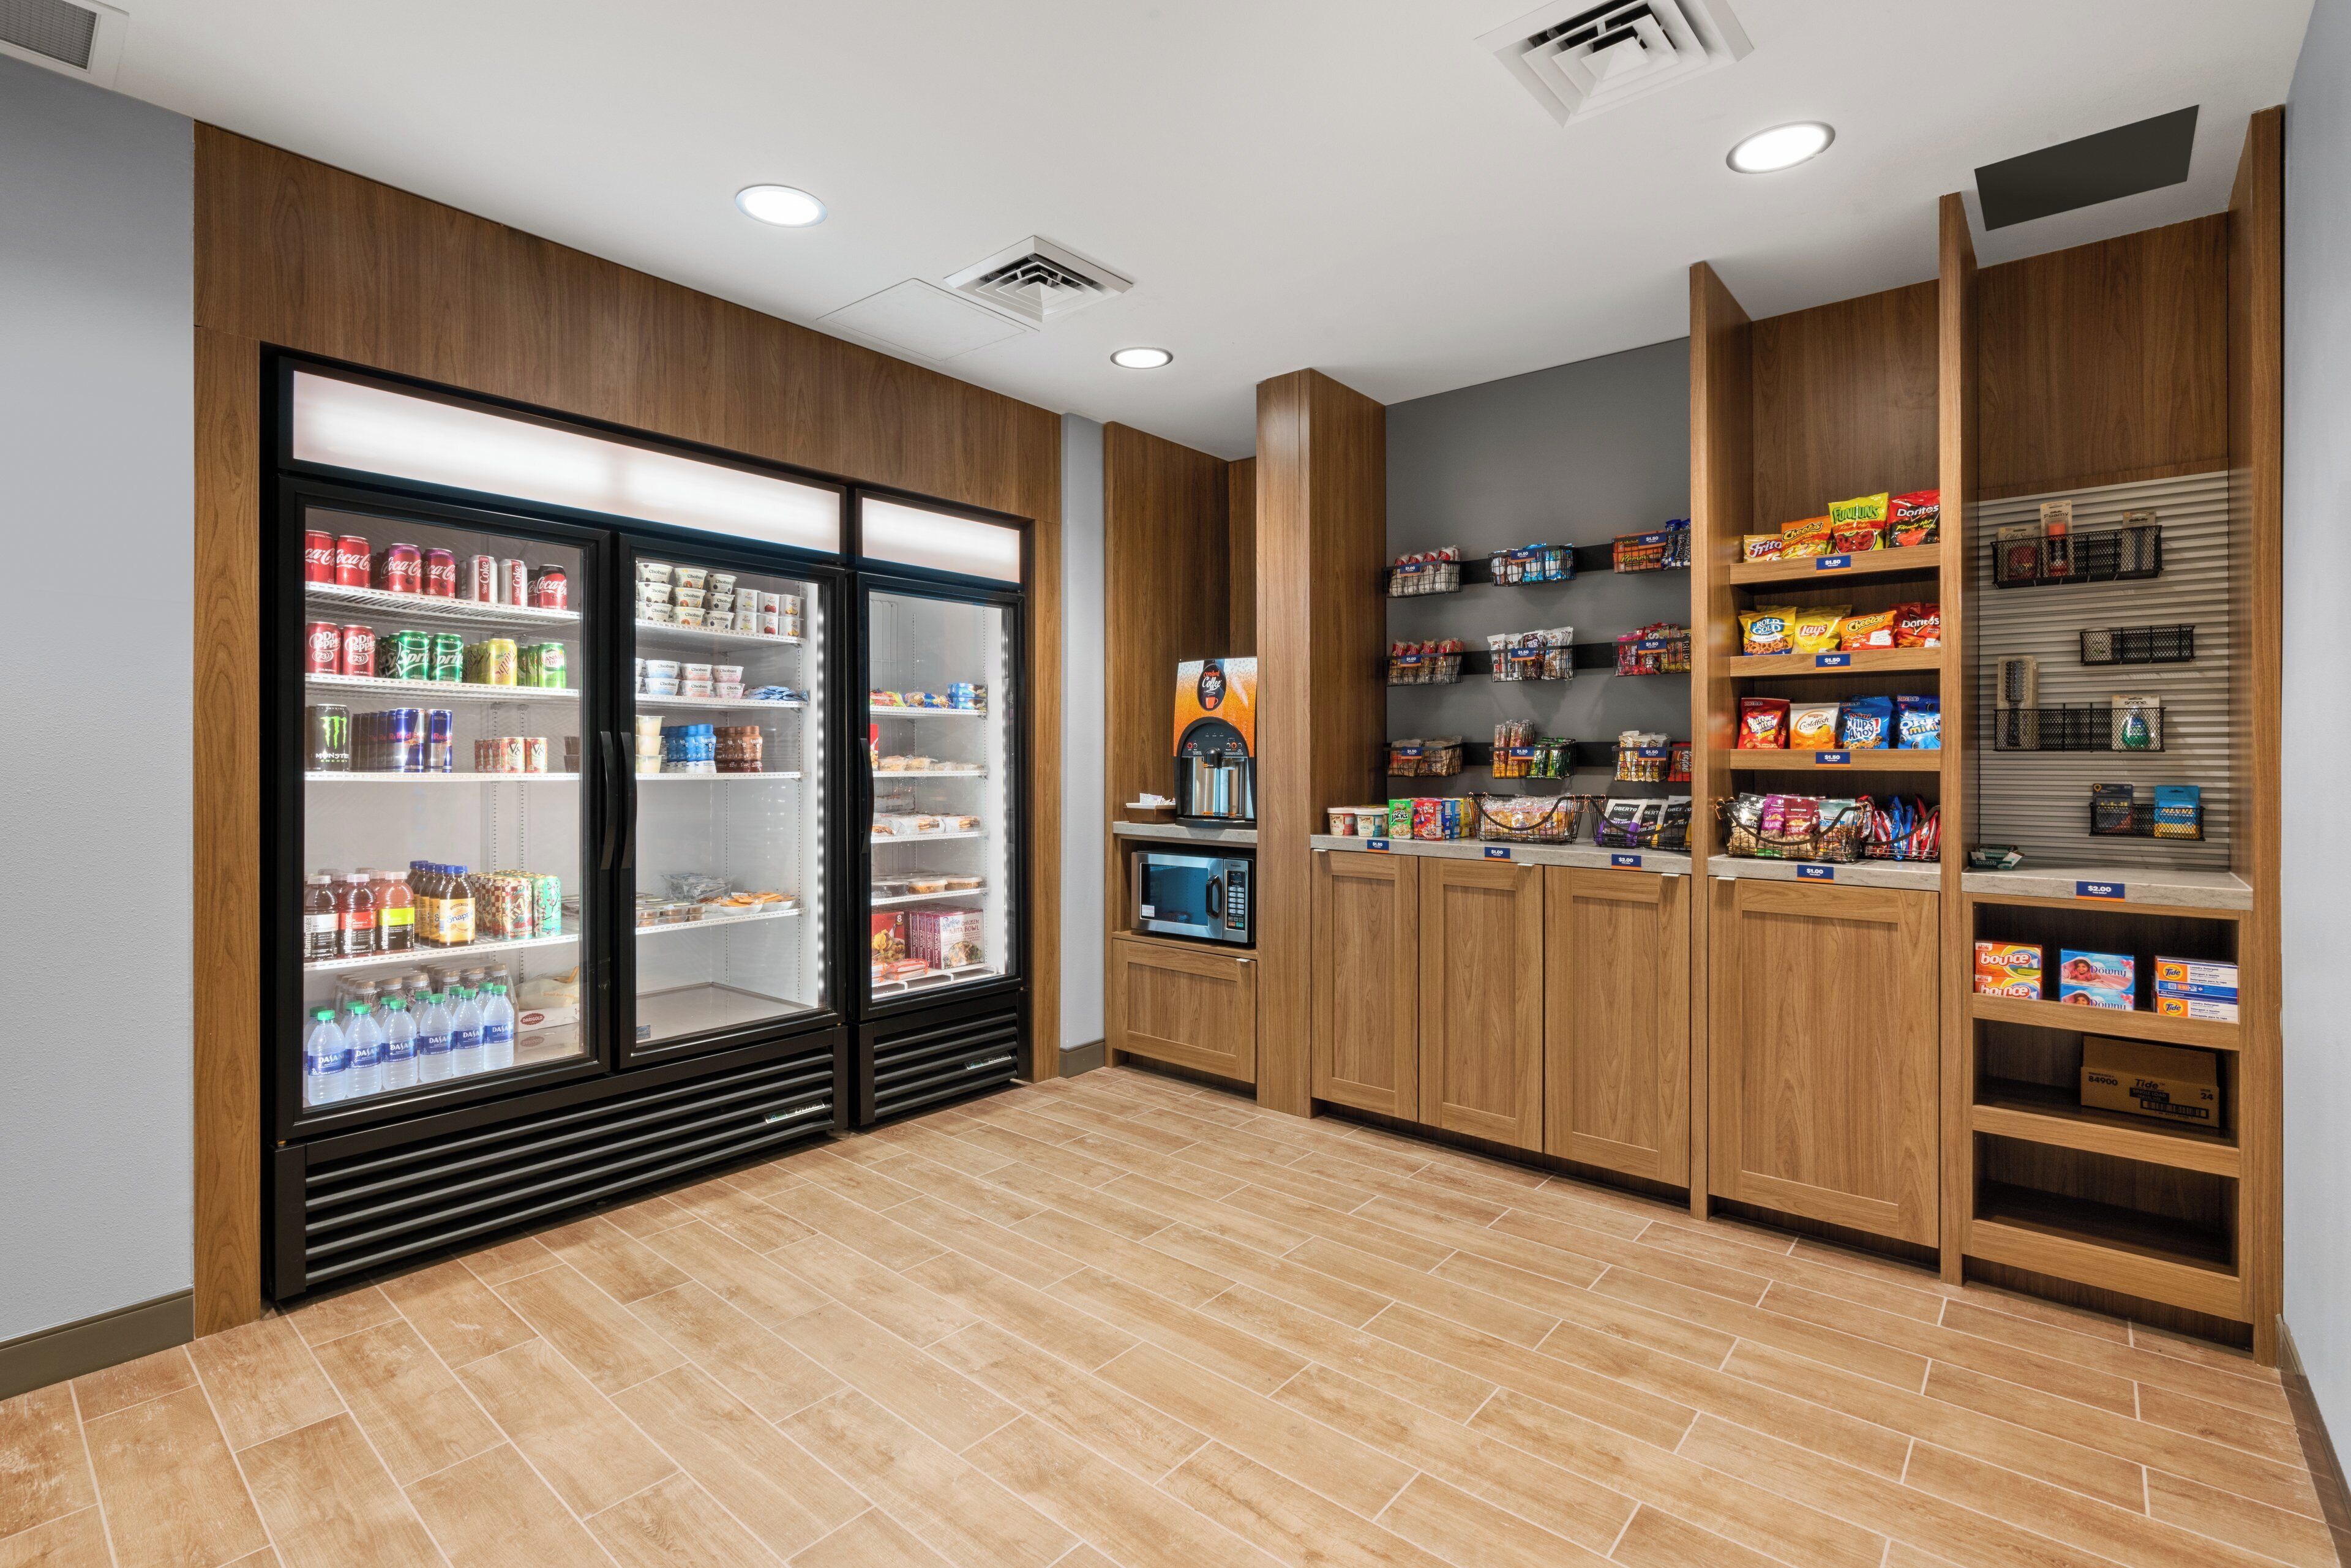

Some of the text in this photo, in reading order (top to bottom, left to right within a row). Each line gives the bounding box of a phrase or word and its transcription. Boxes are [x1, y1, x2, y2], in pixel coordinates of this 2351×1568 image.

[1832, 505, 1880, 525] FUNYUNS
[1897, 505, 1939, 517] Doritos
[1783, 522, 1823, 541] Cheetos
[1749, 539, 1782, 558] Frito
[1621, 553, 1648, 563] Reese's
[479, 561, 490, 583] Coke
[512, 565, 520, 587] Coke
[1752, 624, 1781, 634] GOLD
[1756, 618, 1780, 628] ROLD
[1848, 615, 1885, 631] Cheetos
[1901, 617, 1940, 629] Doritos
[323, 631, 336, 640] Dr
[1800, 625, 1827, 637] Lay's
[358, 634, 370, 643] Dr
[399, 650, 429, 666] Spri
[432, 651, 463, 664] Sprit
[1202, 676, 1222, 691] Coffee
[1747, 715, 1774, 727] Nutter
[1799, 716, 1829, 730] Goldfish
[1847, 718, 1874, 732] Chips
[1909, 724, 1938, 735] mini
[509, 742, 521, 756] V8
[531, 743, 545, 756] V8
[1391, 812, 1408, 823] JACKS
[1980, 952, 2030, 966] bounce
[2090, 965, 2126, 978] Downy
[2163, 967, 2181, 977] Tide
[2163, 1003, 2182, 1013] Tide
[2088, 1076, 2118, 1086] 84900
[2135, 1078, 2159, 1089] Tide
